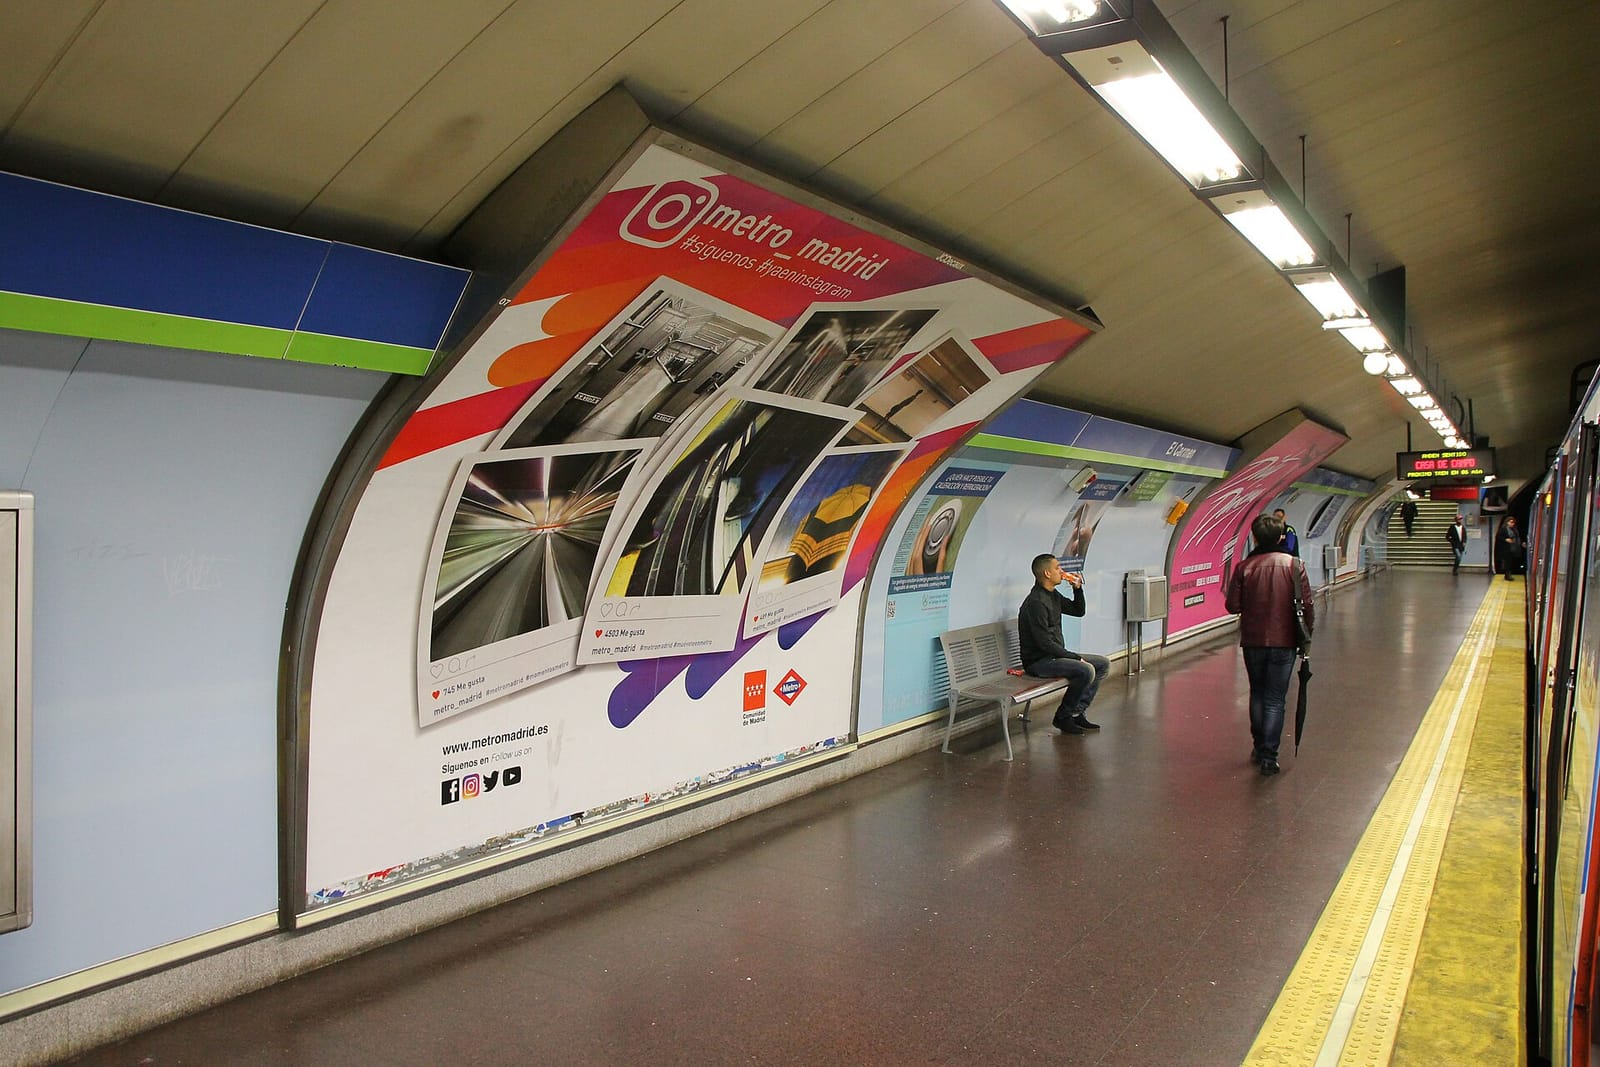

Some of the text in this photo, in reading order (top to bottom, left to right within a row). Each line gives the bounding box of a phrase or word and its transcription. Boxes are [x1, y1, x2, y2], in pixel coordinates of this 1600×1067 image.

[703, 203, 889, 282] metro_madrid
[679, 233, 852, 301] #síguenos #yaeninstagram
[1166, 441, 1197, 459] El Carmen
[1415, 458, 1476, 470] CASA DE CAMPO
[620, 629, 629, 637] Me
[629, 628, 645, 639] gusta
[592, 644, 636, 656] metro_madrid
[443, 675, 485, 697] 745 Me gusta
[782, 683, 800, 693] Metro
[433, 692, 483, 716] metro_madrid
[749, 716, 766, 725] Madrid
[442, 724, 549, 756] www.metromadrid.es
[480, 756, 489, 765] en
[491, 750, 513, 763] Follow
[514, 748, 522, 757] us
[523, 746, 533, 755] on
